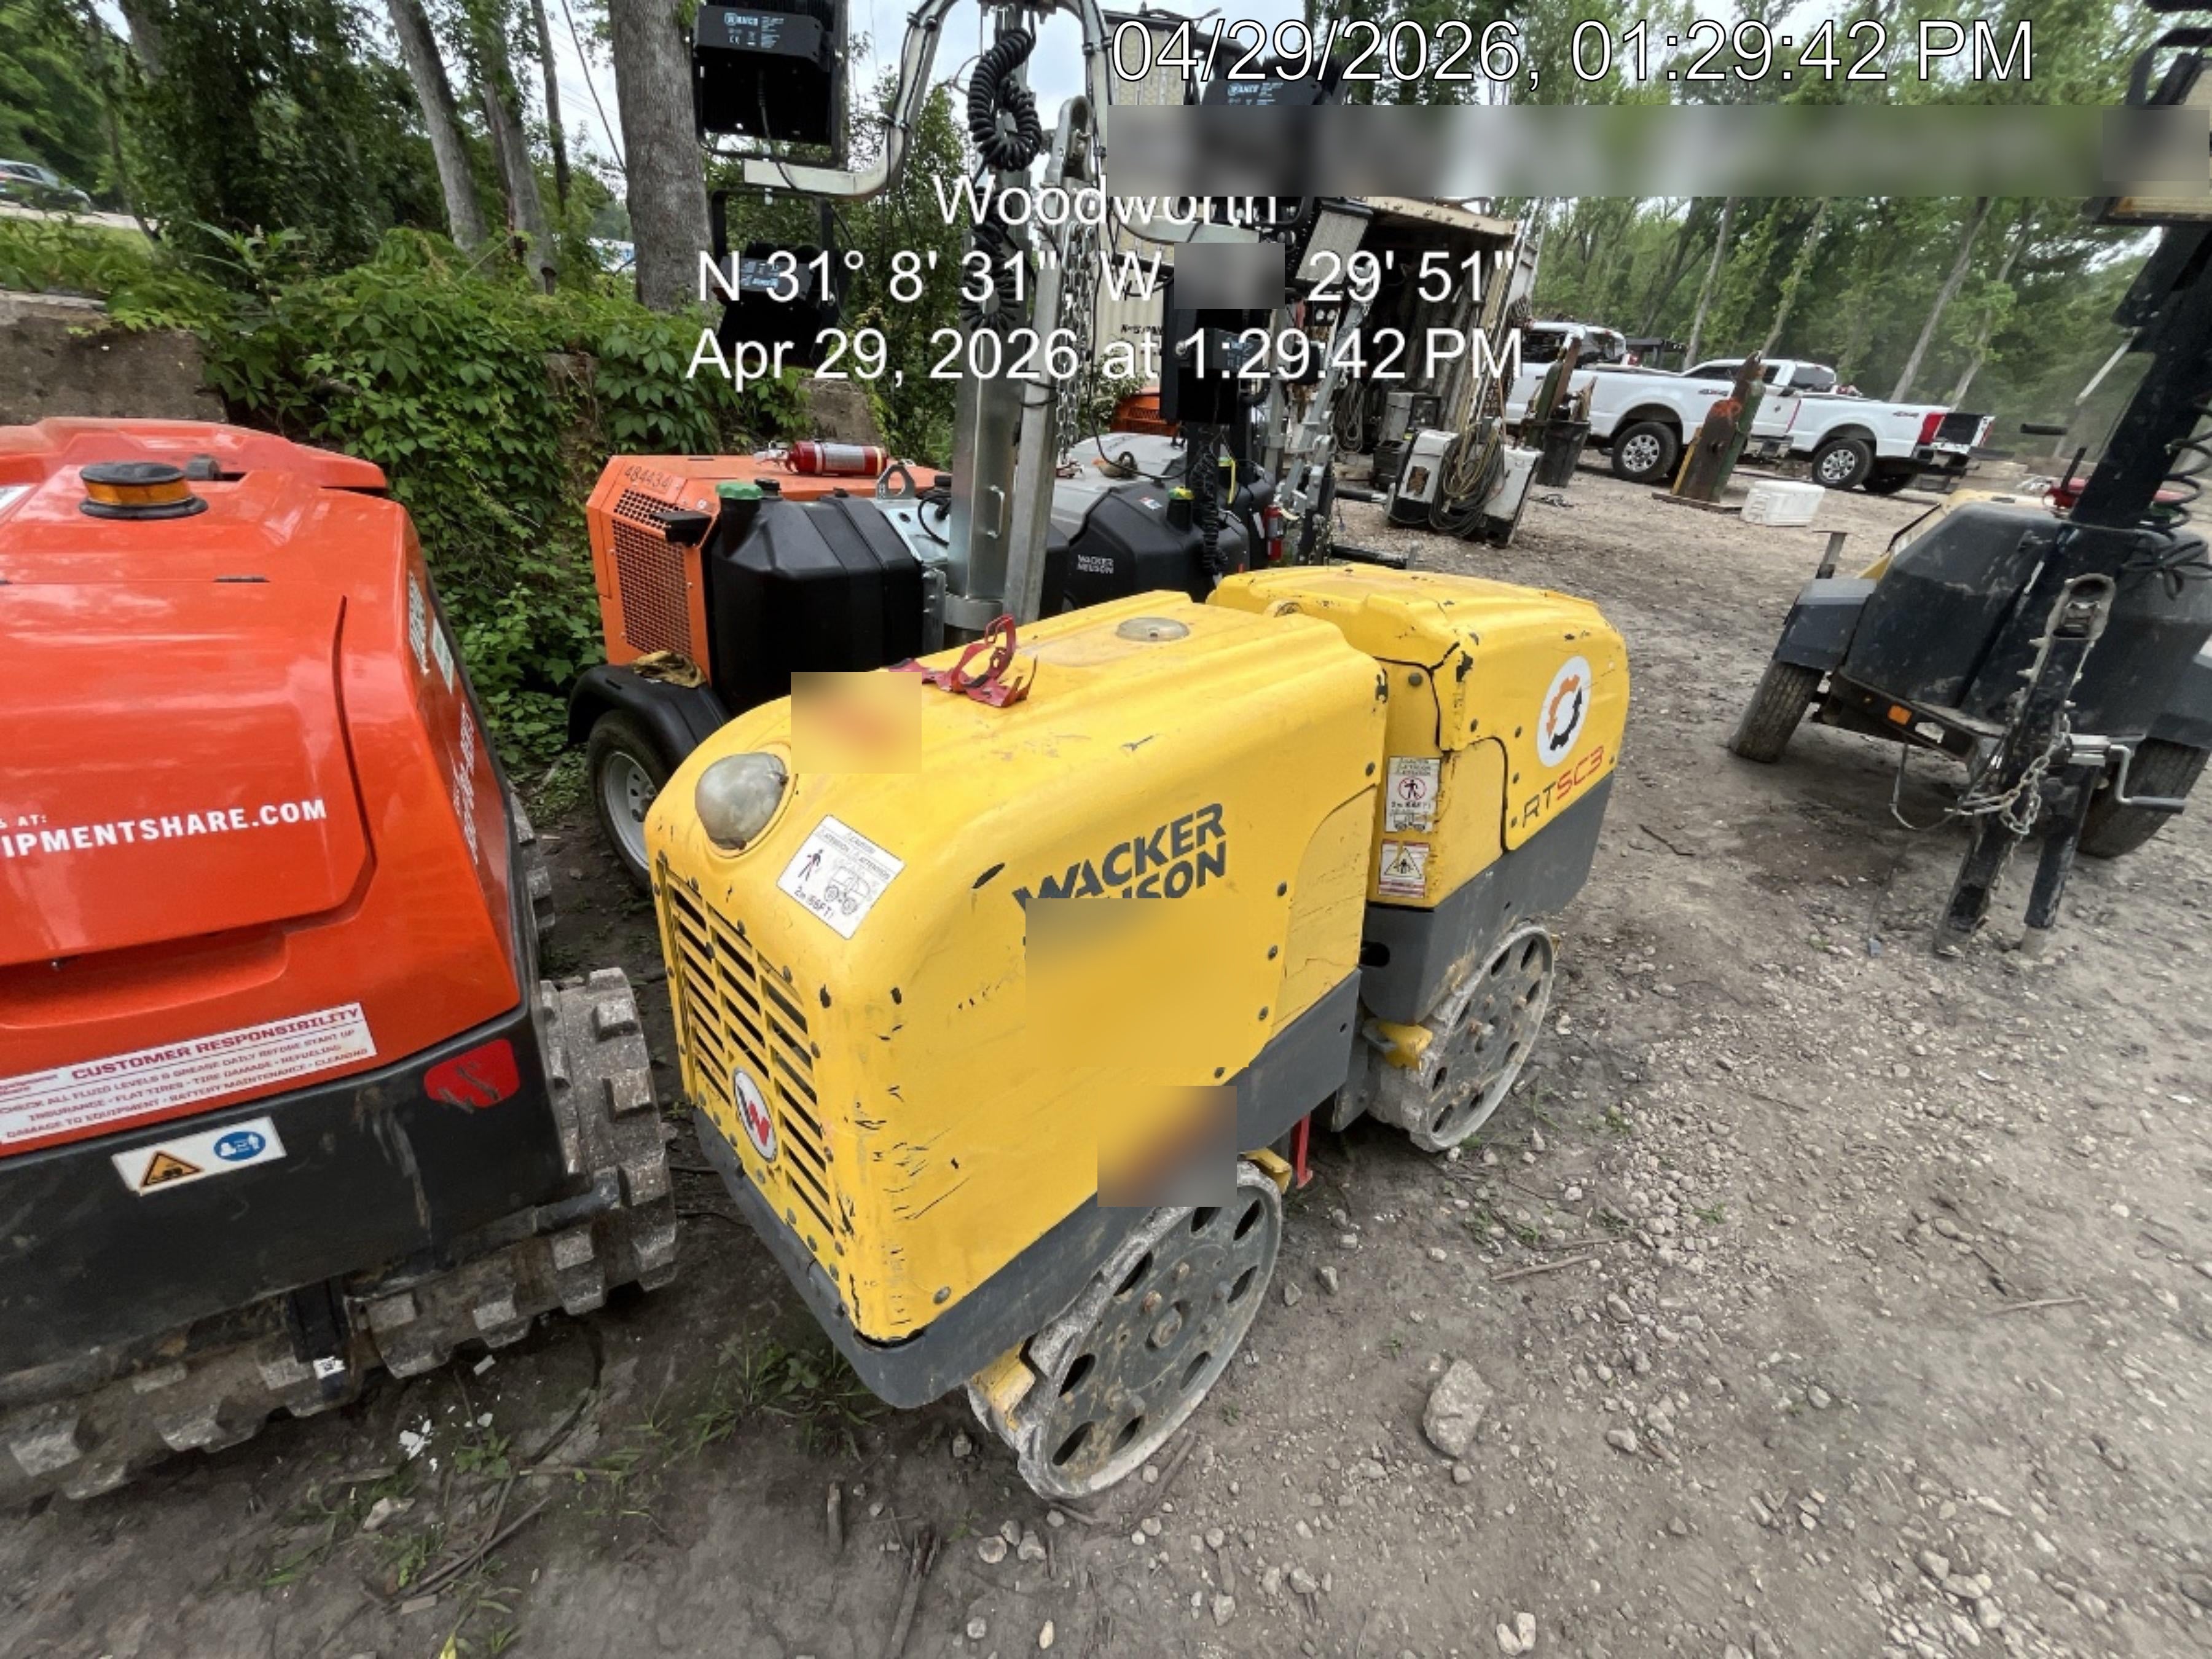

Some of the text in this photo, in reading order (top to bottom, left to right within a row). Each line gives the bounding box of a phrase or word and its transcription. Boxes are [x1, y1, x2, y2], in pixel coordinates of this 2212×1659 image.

[1, 799, 327, 858] IPMENTSHARE.COM
[18, 814, 47, 827] AT:
[1, 1100, 44, 1113] CHECK
[48, 1094, 70, 1105] ALL
[72, 1085, 111, 1099] FLUID
[114, 1075, 159, 1090] LEVELS
[173, 1061, 219, 1077] GREASE
[222, 1053, 255, 1066] DAILY
[259, 1043, 300, 1057] BEFORE
[304, 1033, 337, 1046] START
[340, 1029, 355, 1038] UP
[72, 1008, 359, 1079] CUSTOMER RESPONSIBILITY
[7, 1121, 63, 1138] DAMAGE
[65, 1116, 82, 1125] TO
[85, 1099, 160, 1120] EQUIPMENT
[169, 1085, 221, 1102] BATTERY
[224, 1064, 306, 1089] MAINTENANCE
[29, 1045, 342, 1121] INSURANCE FLAT TIRES TIRE DAMAGE REFUELING
